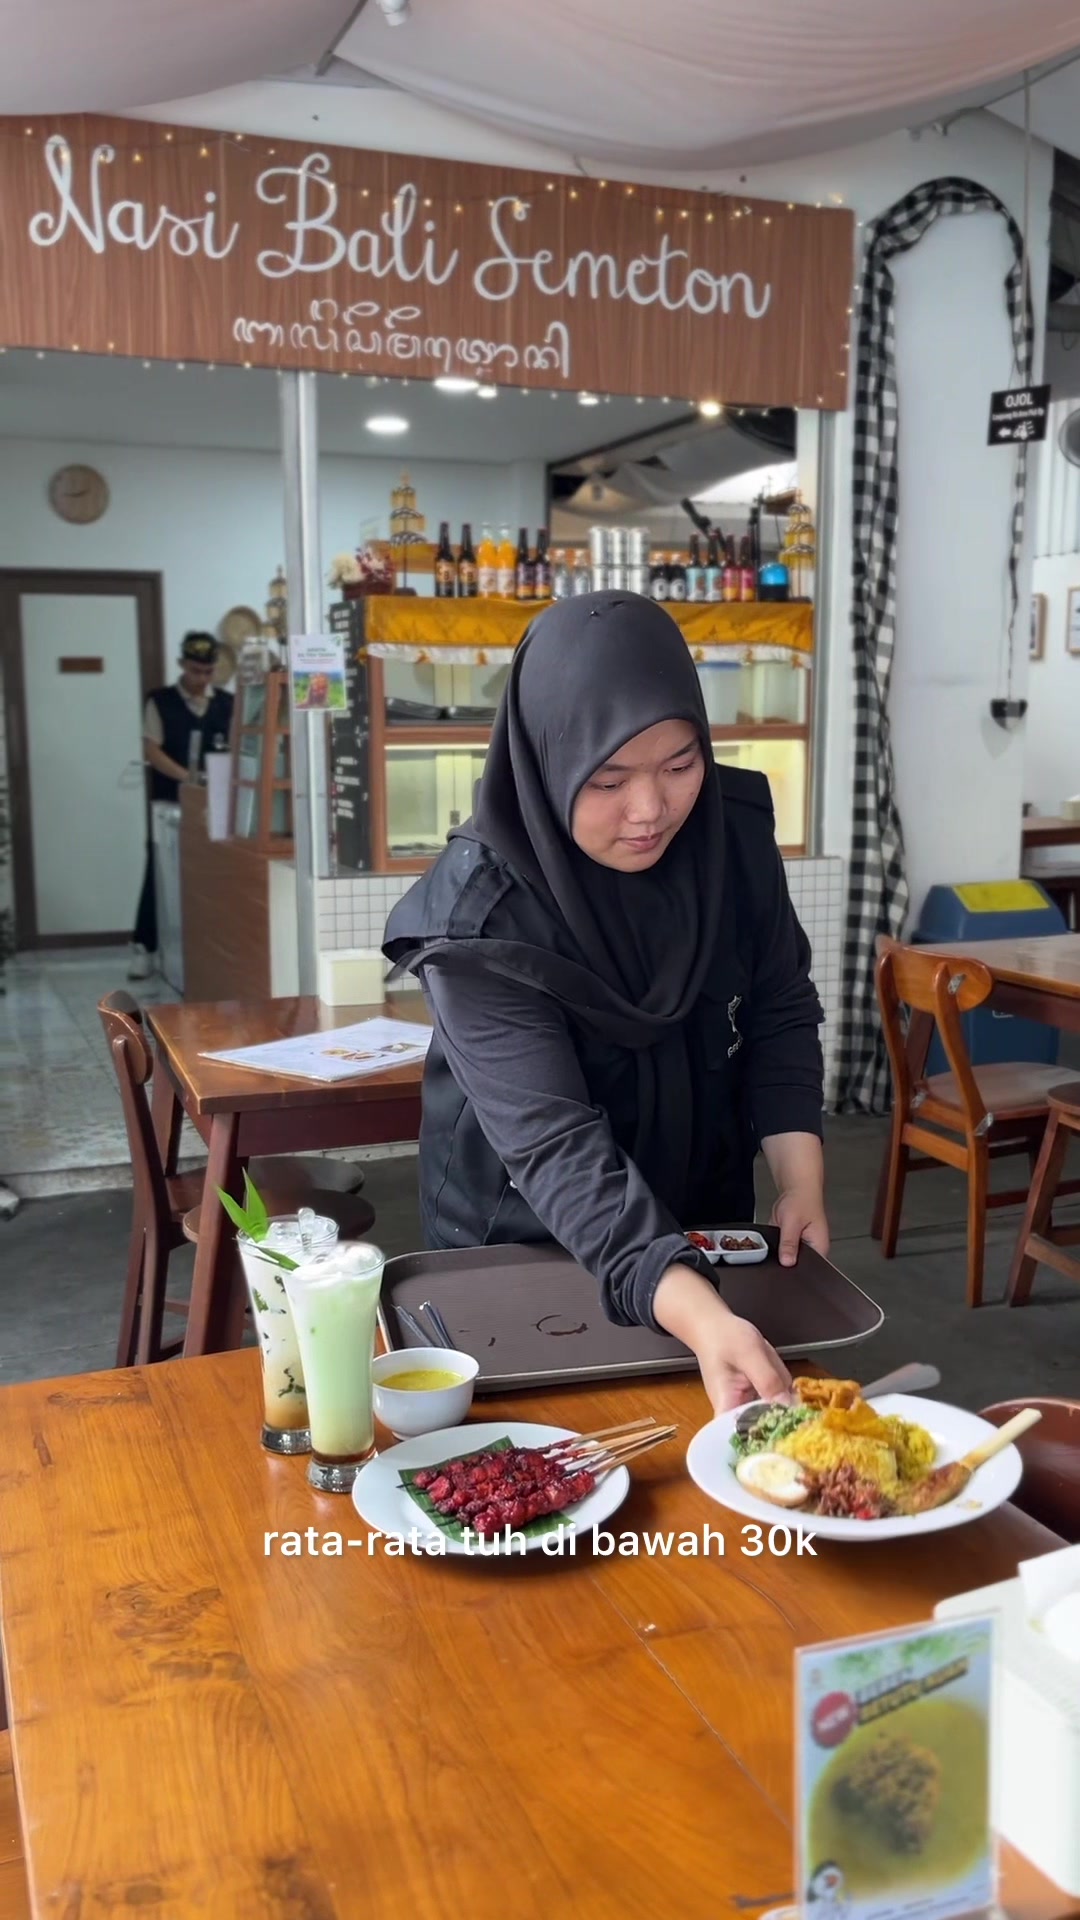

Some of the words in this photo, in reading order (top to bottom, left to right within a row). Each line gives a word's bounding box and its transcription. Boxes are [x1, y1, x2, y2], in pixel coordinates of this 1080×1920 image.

[28, 133, 241, 261] Nasi
[255, 152, 459, 287] Bali
[473, 196, 771, 320] Semeton
[1005, 393, 1033, 408] OJOL
